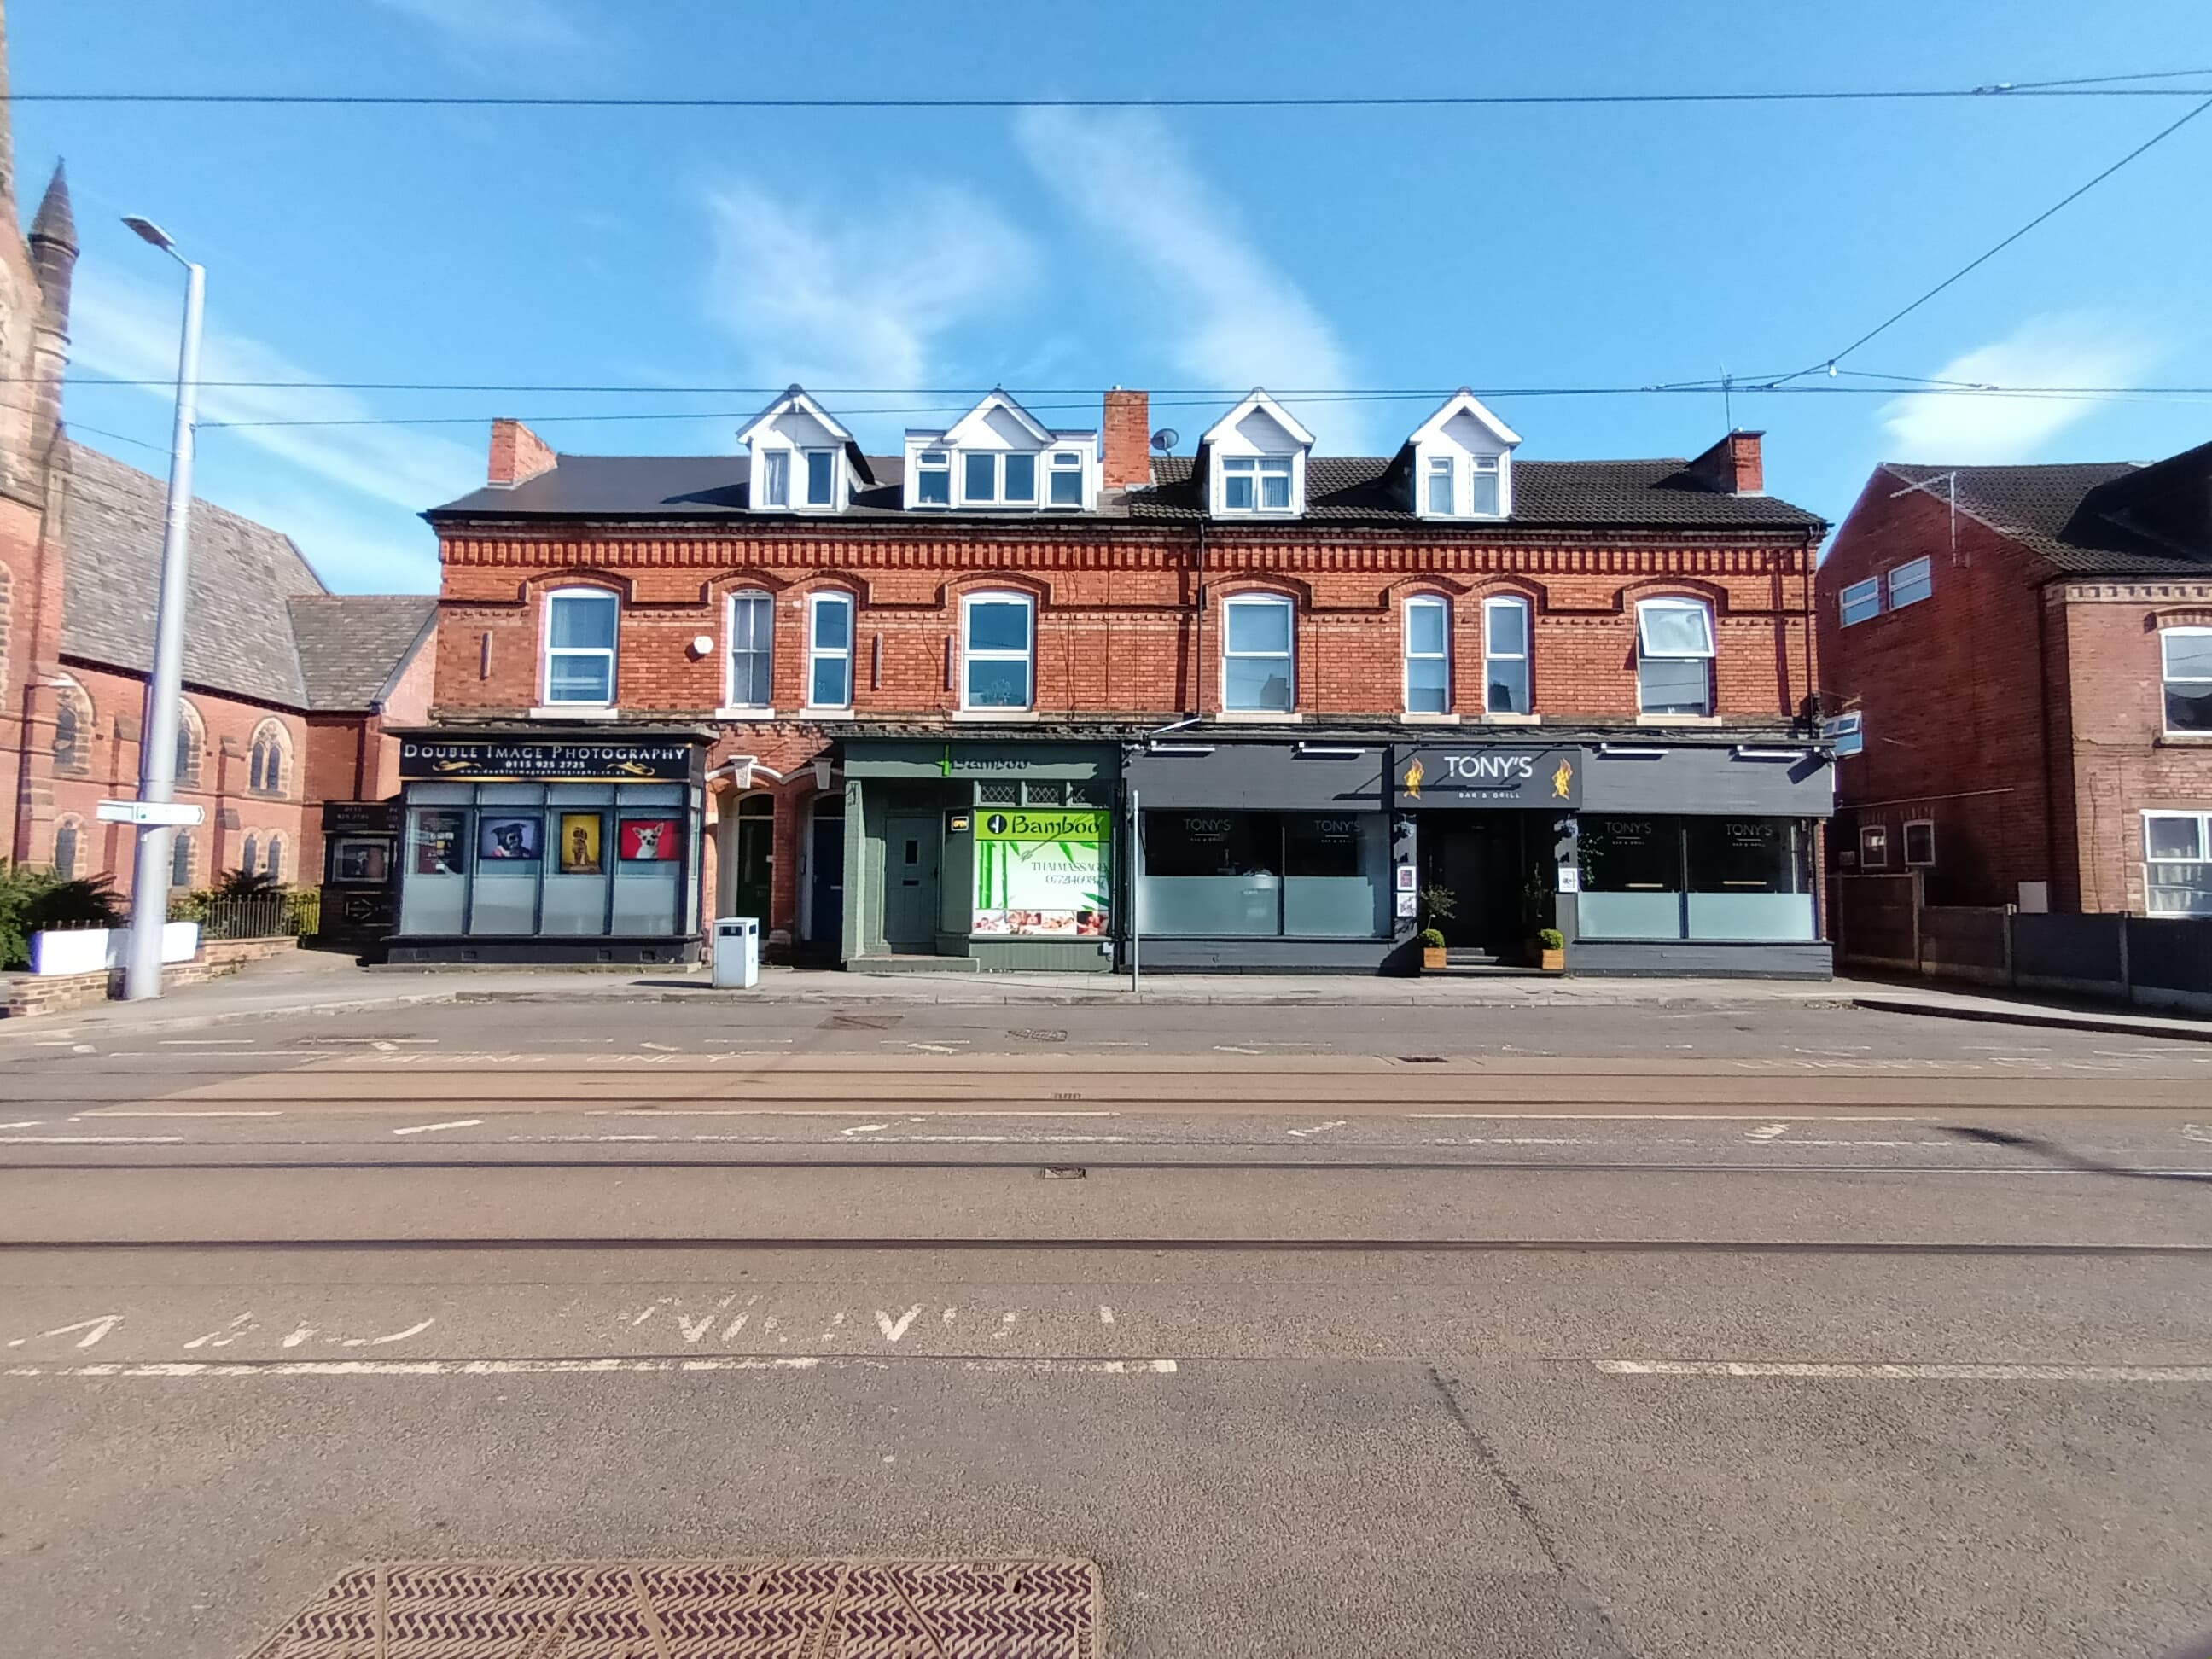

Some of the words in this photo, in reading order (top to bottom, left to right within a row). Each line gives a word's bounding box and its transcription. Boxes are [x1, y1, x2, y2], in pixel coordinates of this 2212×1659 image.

[404, 744, 478, 759] DOUBLE
[486, 745, 543, 759] IMAGE
[551, 745, 685, 760] PHOTOGRAPHY
[1444, 756, 1533, 777] TONY'S
[1011, 815, 1100, 834] Bamboo
[1183, 818, 1231, 831] TONY'S
[1315, 819, 1362, 832] TONY'S
[1605, 821, 1652, 834] TONY'S
[1726, 824, 1773, 835] TONY'S
